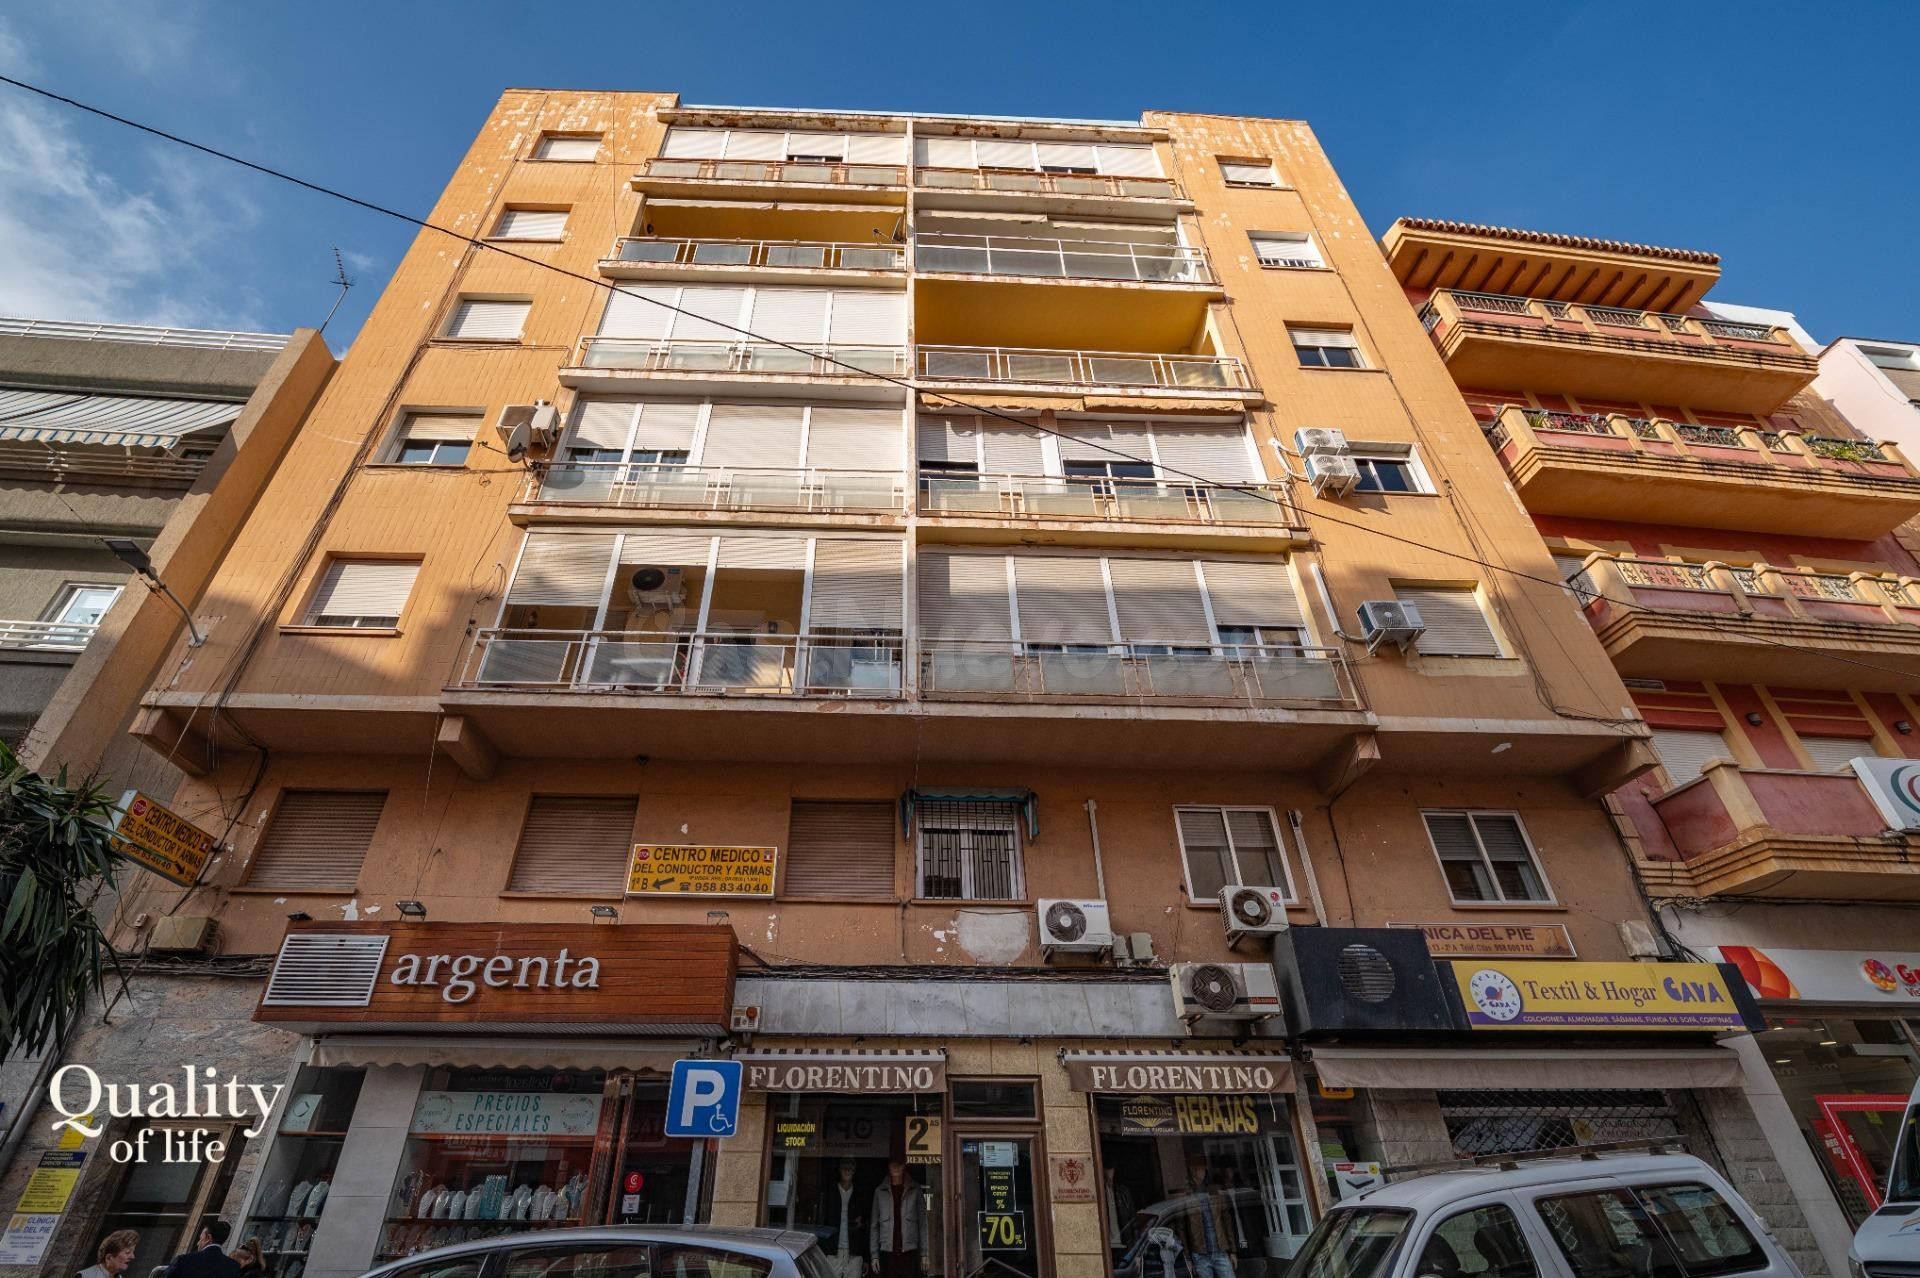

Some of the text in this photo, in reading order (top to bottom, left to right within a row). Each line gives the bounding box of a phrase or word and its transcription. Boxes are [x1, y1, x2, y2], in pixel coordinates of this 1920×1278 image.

[145, 806, 201, 849] CENTRO MEDICO
[121, 815, 136, 833] DEL
[136, 824, 176, 852] CONDUCTOR
[180, 850, 203, 869] ARMAS
[653, 848, 760, 863] CENTRO MEDICO
[633, 863, 772, 876] DEL CONDUCTOR Y ARMAS
[641, 878, 649, 890] B
[694, 882, 717, 892] 958
[719, 882, 734, 892] 83
[736, 883, 751, 893] 40
[753, 883, 769, 893] 40
[1466, 928, 1499, 941] DEL
[1505, 928, 1535, 941] PIE
[390, 948, 600, 1004] argenta
[1523, 979, 1579, 1001] Textil
[1585, 982, 1600, 1001] &
[1604, 981, 1658, 1008] Hogar
[748, 1067, 933, 1090] FLORENTINO
[1091, 1067, 1274, 1090] FLORENTINO
[473, 1094, 541, 1112] PRECIOS
[681, 1069, 725, 1125] P
[455, 1113, 551, 1132] ESPECIALES
[1121, 1094, 1260, 1135] FLORENTINO REBAJAS
[776, 1122, 815, 1133] LIQUIDACIÓN
[784, 1136, 806, 1147] STOCK
[906, 1155, 942, 1165] REBAJAS
